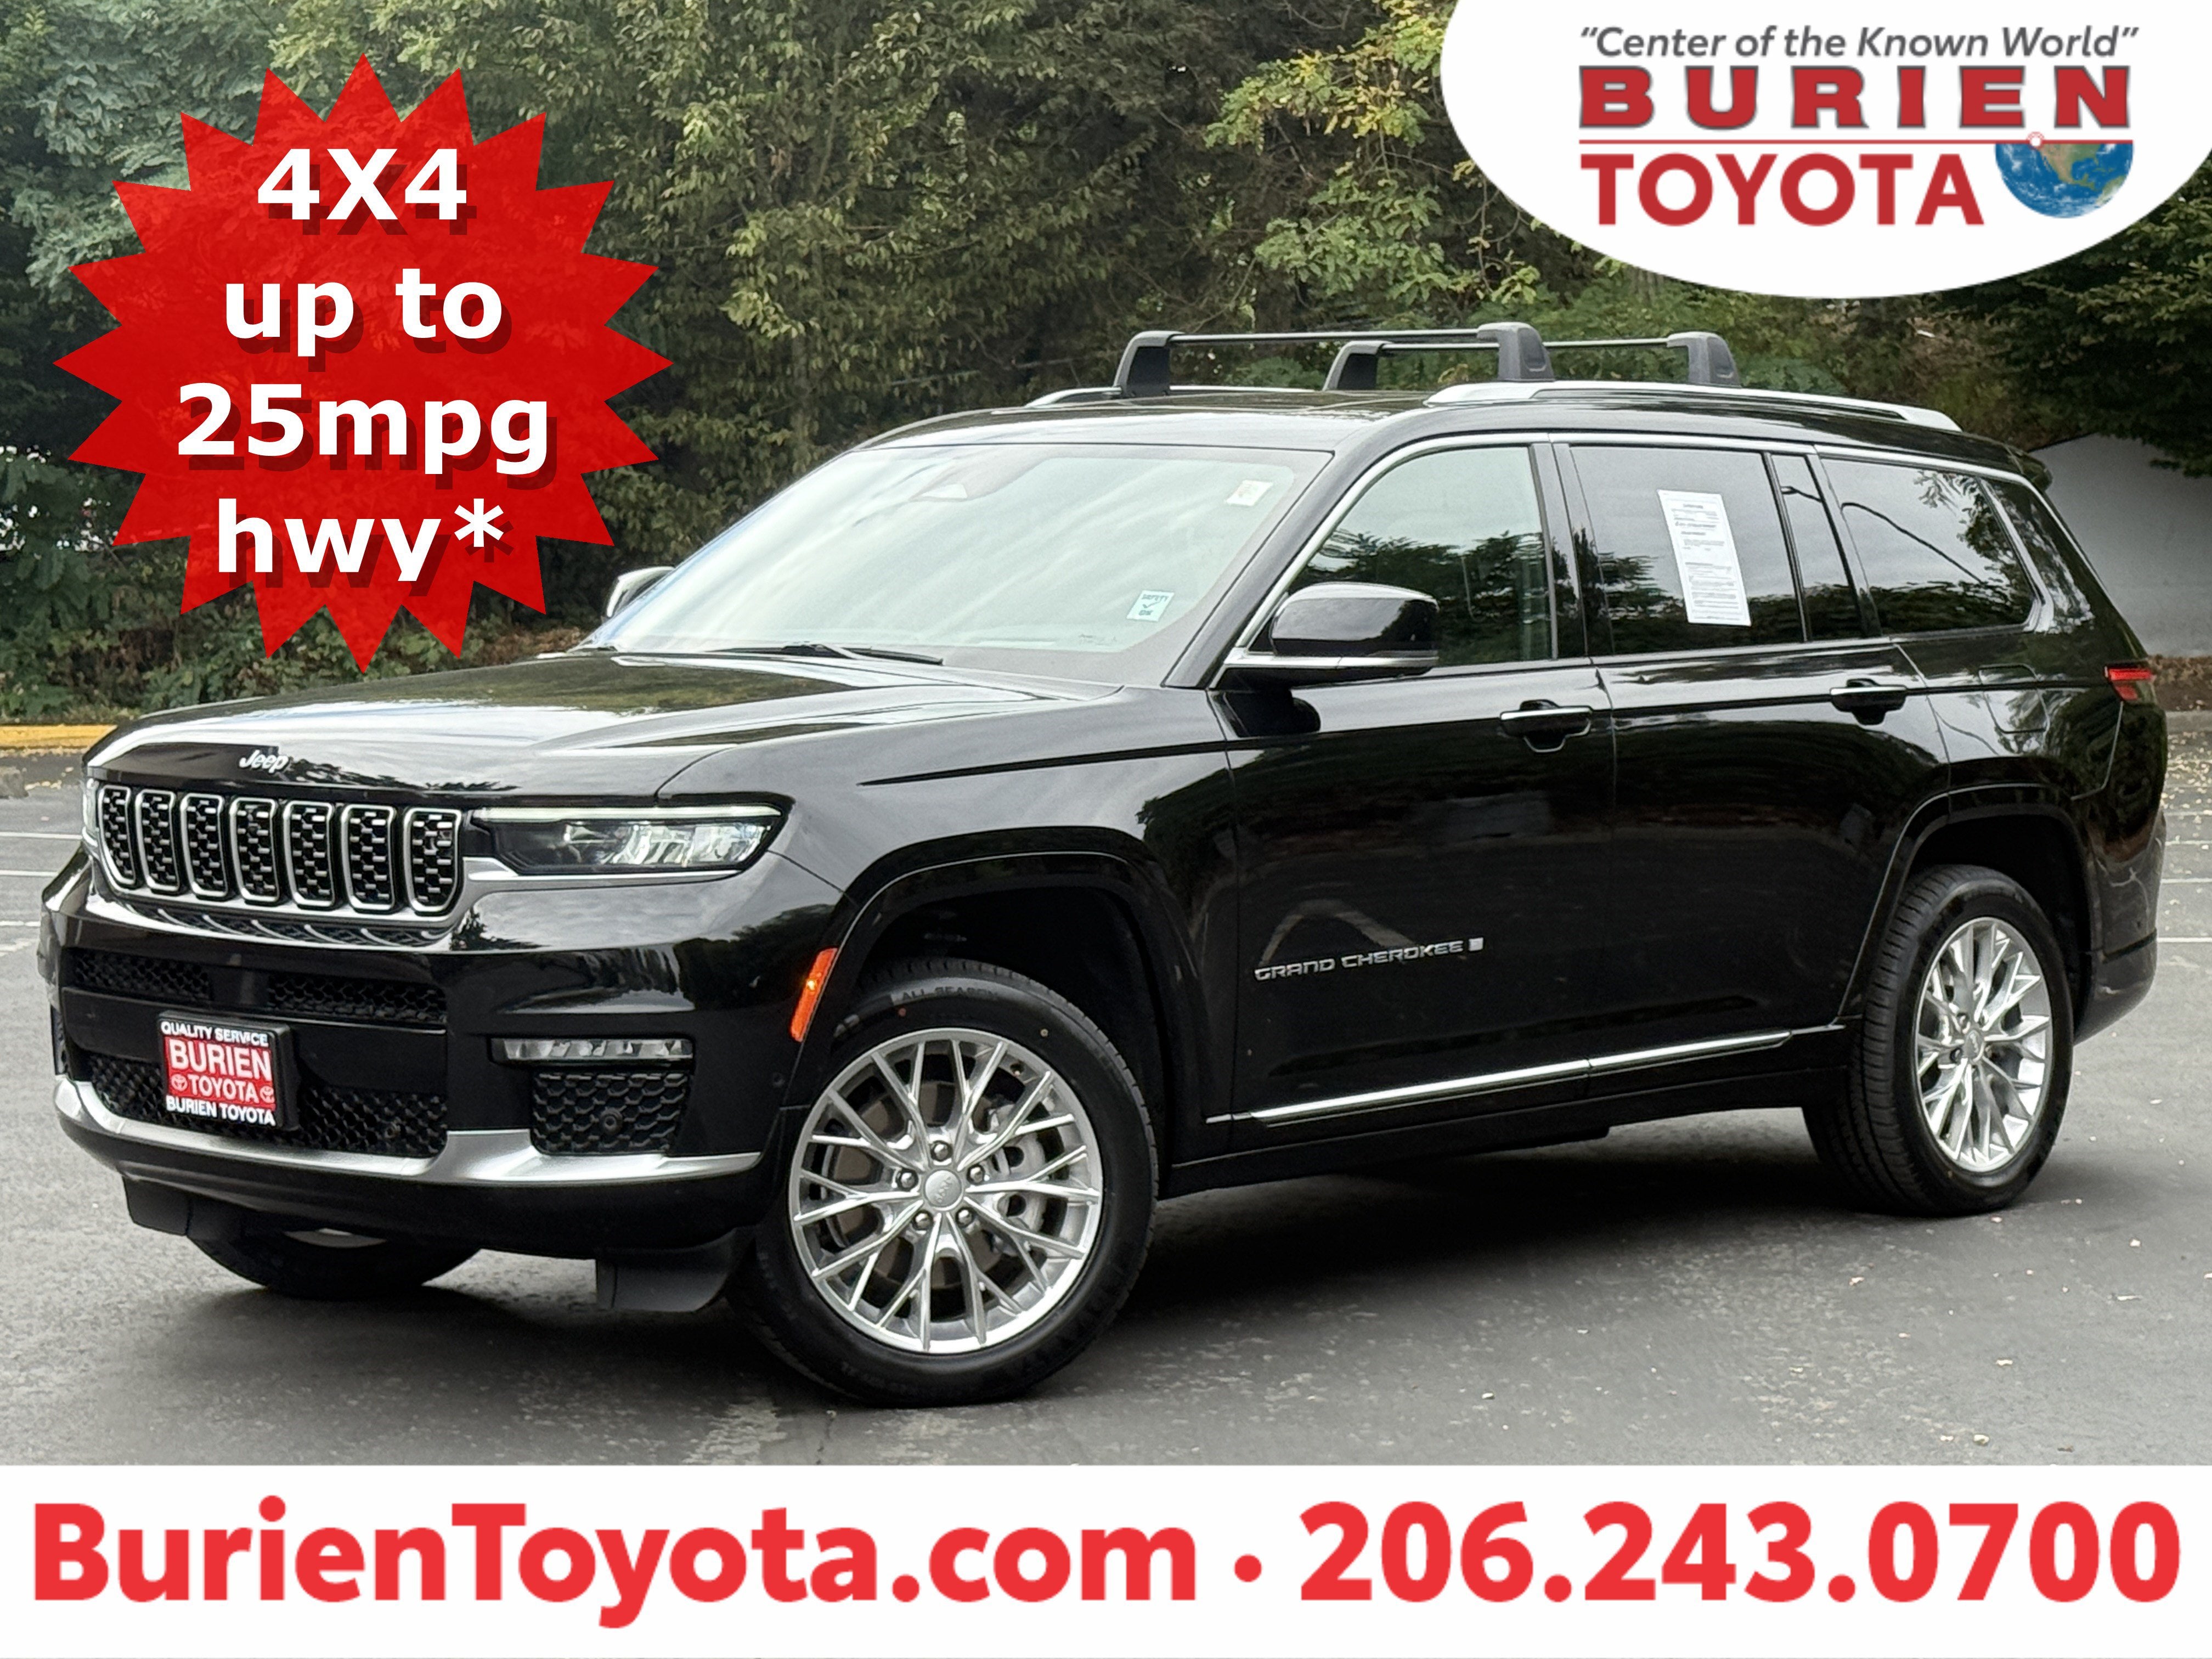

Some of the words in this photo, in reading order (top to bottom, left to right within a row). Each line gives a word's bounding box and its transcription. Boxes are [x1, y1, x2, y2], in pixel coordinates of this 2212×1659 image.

[239, 749, 289, 774] Jeep
[1255, 958, 1335, 981] GRAND
[1341, 940, 1464, 968] CHEROKEE
[161, 1021, 213, 1040] QUALITY
[215, 1028, 269, 1047] SERVICE
[168, 1039, 272, 1081] BURIEN
[188, 1074, 259, 1104] TOYOTA
[166, 1095, 217, 1118] BURIEN
[219, 1102, 275, 1126] TOYOTA
